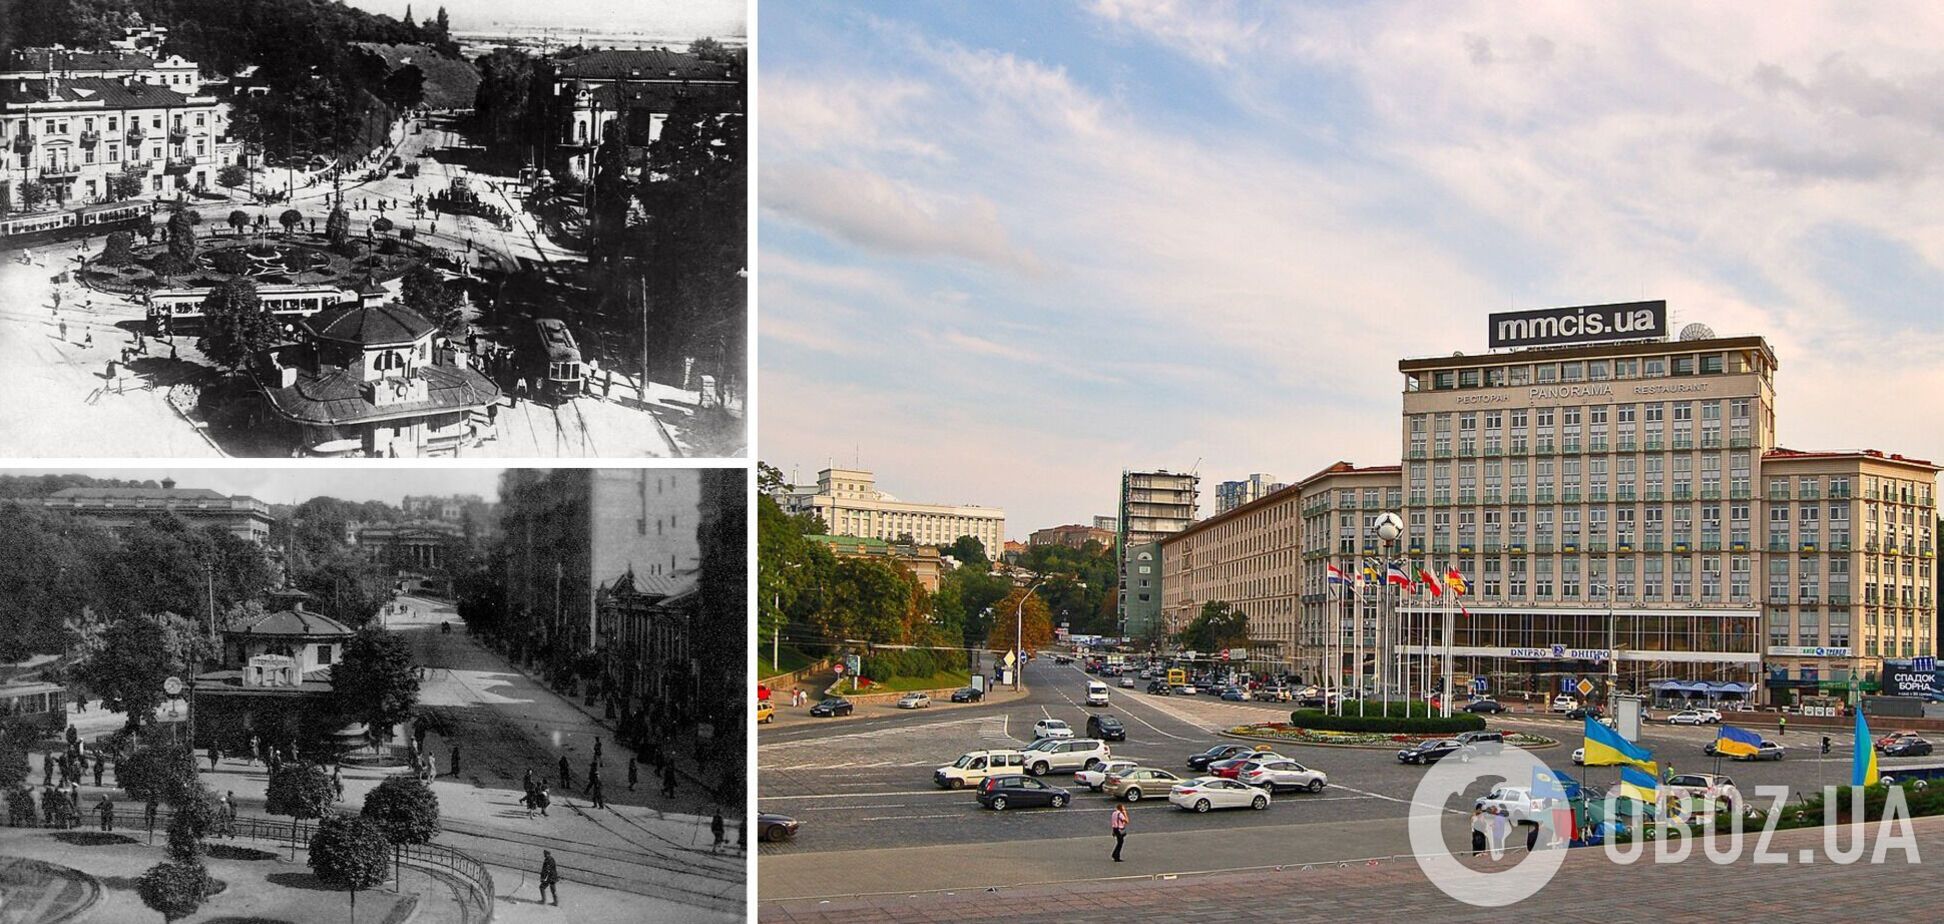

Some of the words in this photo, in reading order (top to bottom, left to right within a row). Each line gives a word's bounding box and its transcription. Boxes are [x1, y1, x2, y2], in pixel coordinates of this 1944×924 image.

[1498, 308, 1655, 340] mmcis.ua
[1529, 384, 1613, 399] PANORAMA
[1633, 384, 1708, 395] RESTAURANT
[1456, 393, 1510, 404] РЕСТОРАН
[1510, 649, 1546, 657] DNIPRO
[1894, 673, 1936, 683] СПАДОК
[1899, 682, 1931, 690] БОРНА
